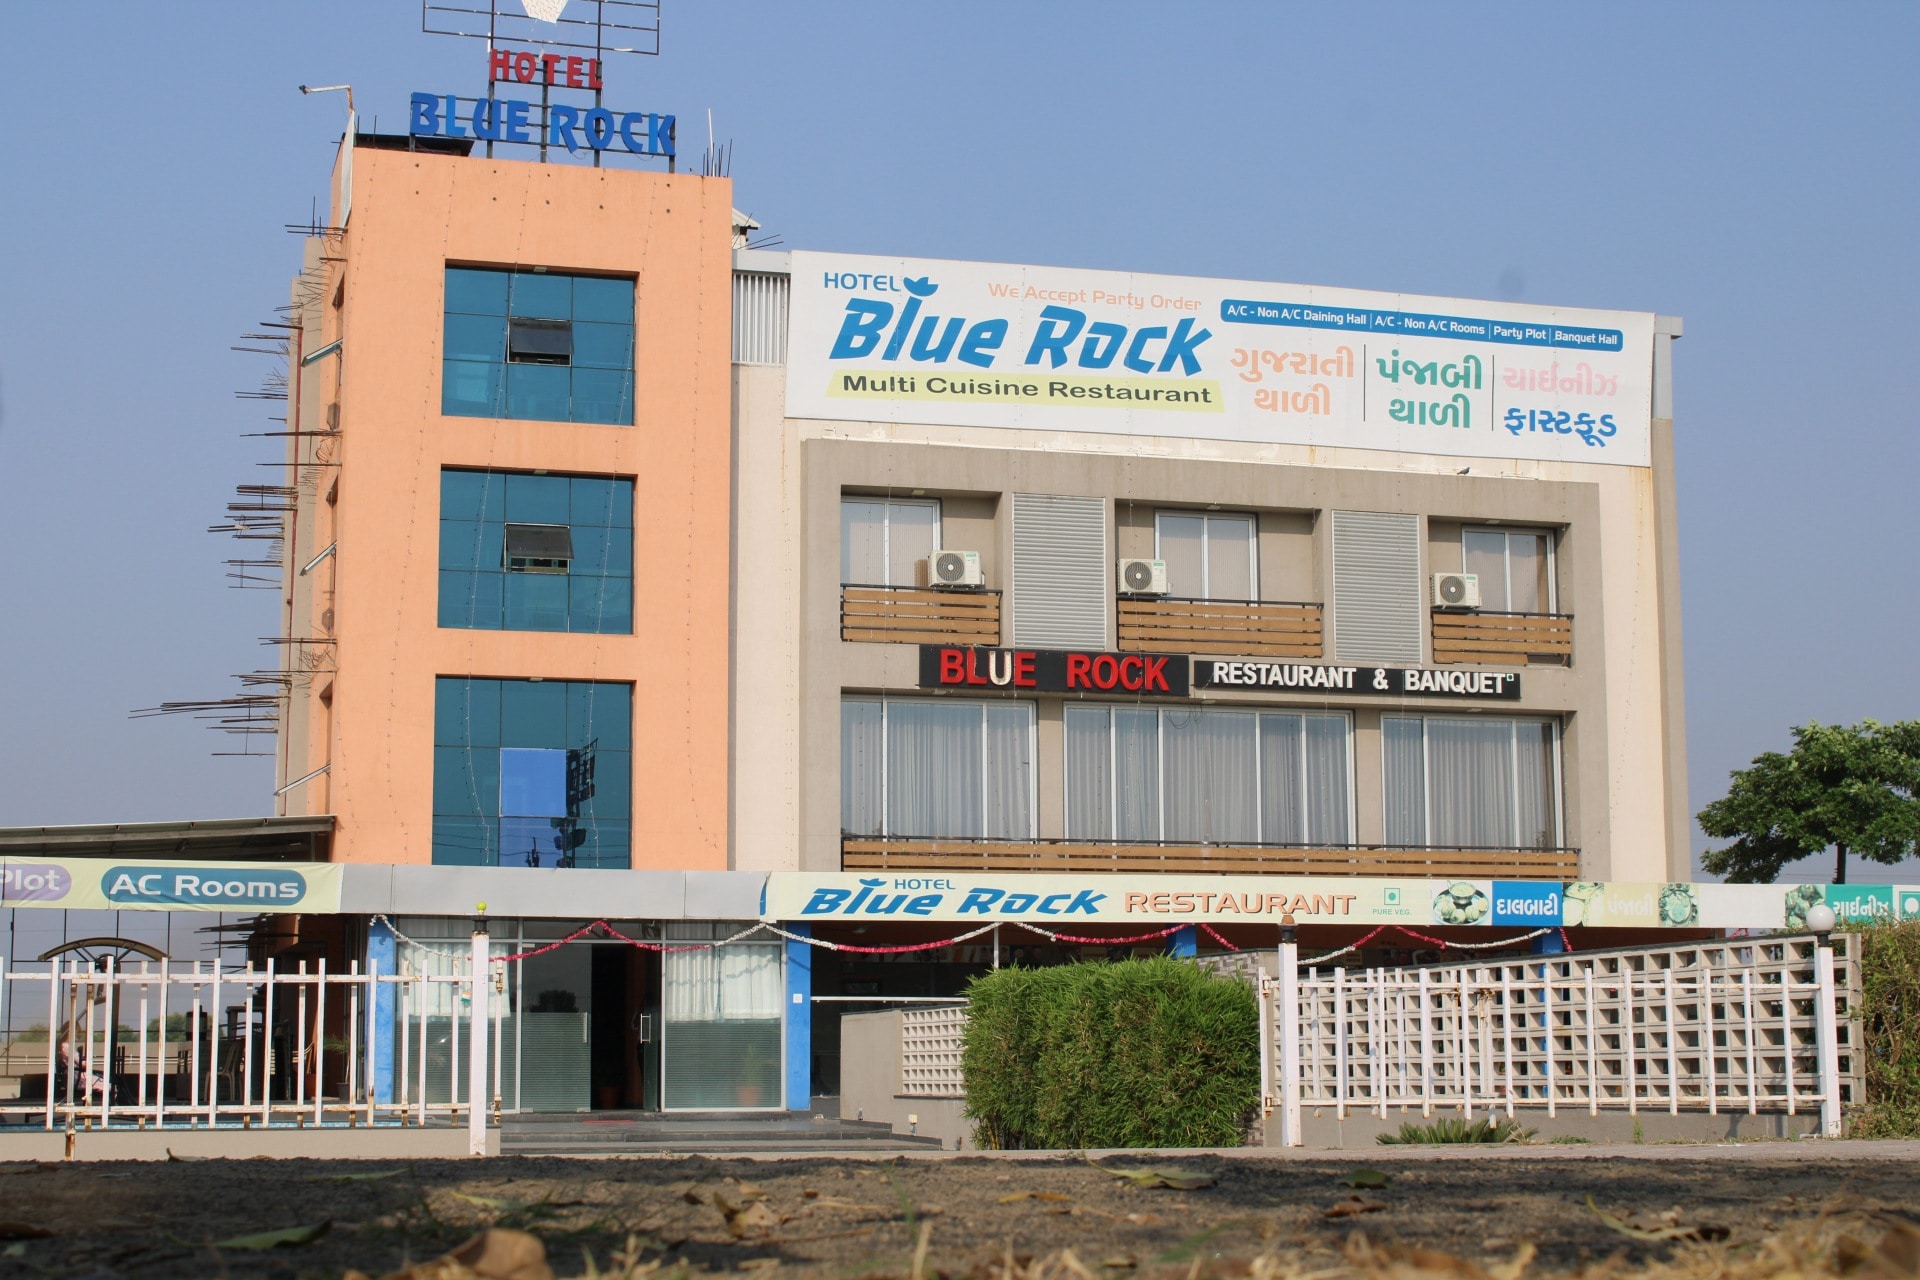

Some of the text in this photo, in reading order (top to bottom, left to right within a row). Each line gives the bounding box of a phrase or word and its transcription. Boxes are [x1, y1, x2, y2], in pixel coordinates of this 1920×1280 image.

[489, 48, 603, 90] HOTEL
[411, 92, 676, 156] BLUE ROCK
[823, 271, 901, 293] HOTEL
[988, 283, 1202, 311] We Accept Party Order
[1227, 304, 1248, 317] A/C
[1257, 307, 1279, 318] Non
[1281, 308, 1301, 320] A/C
[1304, 310, 1344, 325] Daining
[1346, 313, 1367, 325] Hall
[1375, 315, 1395, 327] A/C
[1404, 318, 1425, 329] Non
[1427, 319, 1448, 331] A/C
[1450, 322, 1485, 334] Rooms
[829, 296, 1213, 377] Blue Rock
[1493, 325, 1547, 340] Party Plot
[1555, 330, 1618, 345] Banquet Hall
[1230, 345, 1354, 383] ગુજરાતી
[1376, 349, 1482, 390] પંજાબી
[843, 374, 1212, 403] Multi Cuisine Restaurant
[1253, 383, 1331, 416] થાળી
[1388, 393, 1470, 429] થાળી
[940, 648, 1170, 692] BLUE ROCK
[1213, 661, 1506, 695] RESTAURANT & BANQUET
[109, 873, 299, 899] AC Rooms
[894, 878, 956, 890] HOTEL
[800, 886, 1108, 916] Blue Rock
[1124, 891, 1357, 916] RESTAURANT
[1372, 908, 1412, 916] PURE VEG.
[1496, 892, 1559, 916] દાલબાટી
